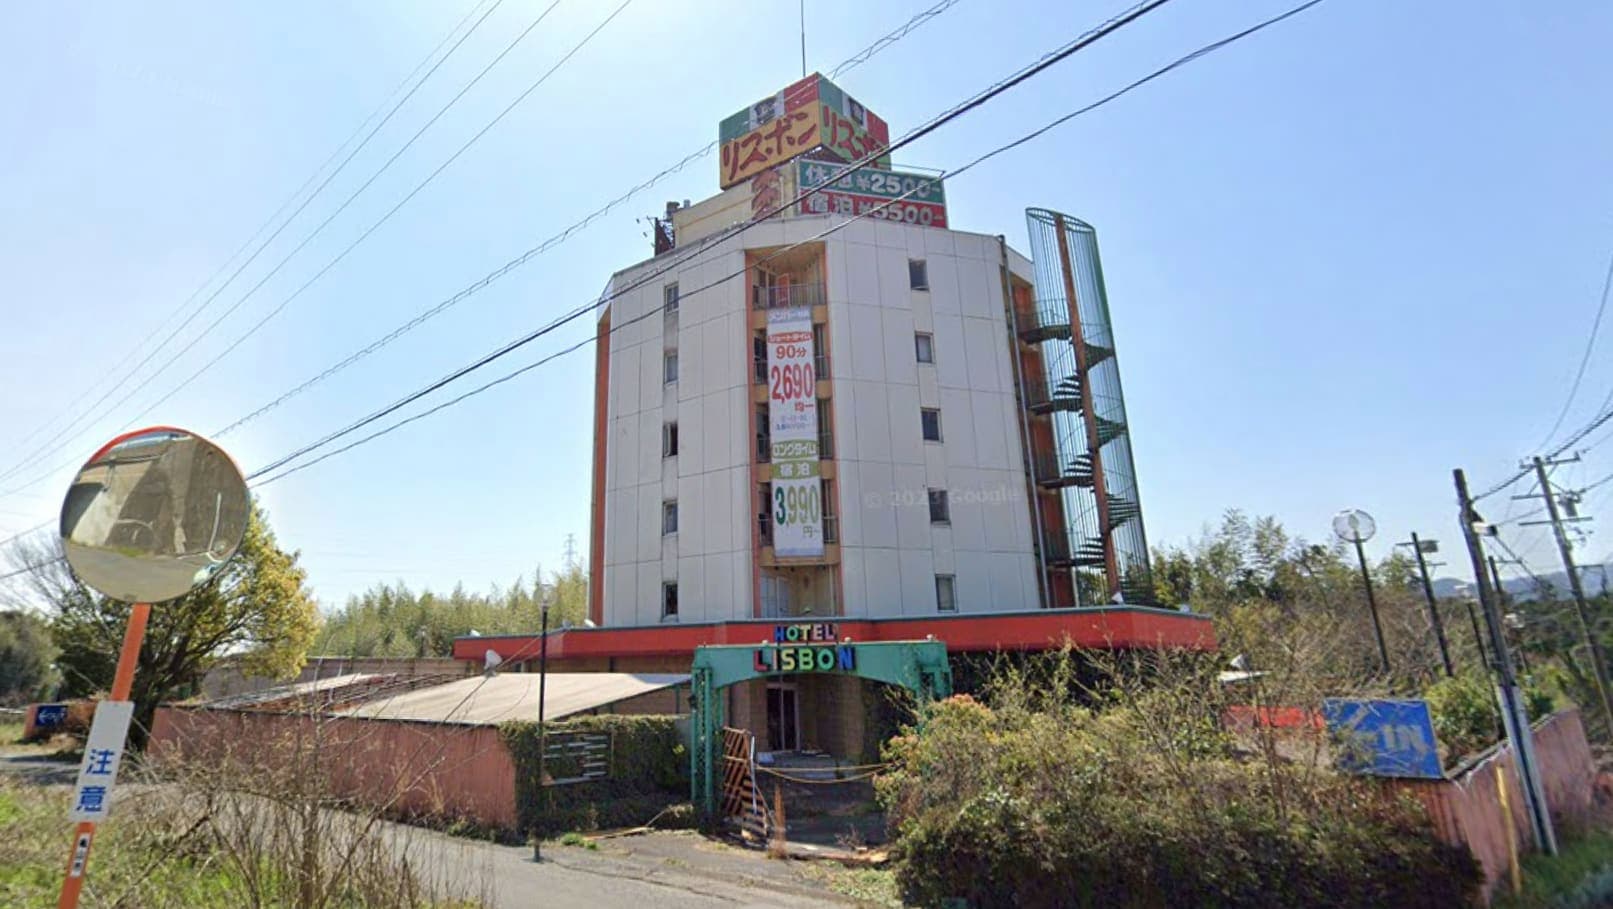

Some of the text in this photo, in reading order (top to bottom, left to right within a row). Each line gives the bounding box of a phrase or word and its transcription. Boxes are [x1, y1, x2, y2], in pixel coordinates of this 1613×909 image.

[776, 345, 807, 359] 90分
[771, 363, 813, 404] 2,690
[775, 485, 819, 528] 3,990
[774, 624, 836, 642] HOTEL
[753, 646, 855, 672] LISBON
[76, 748, 115, 812] 注意
